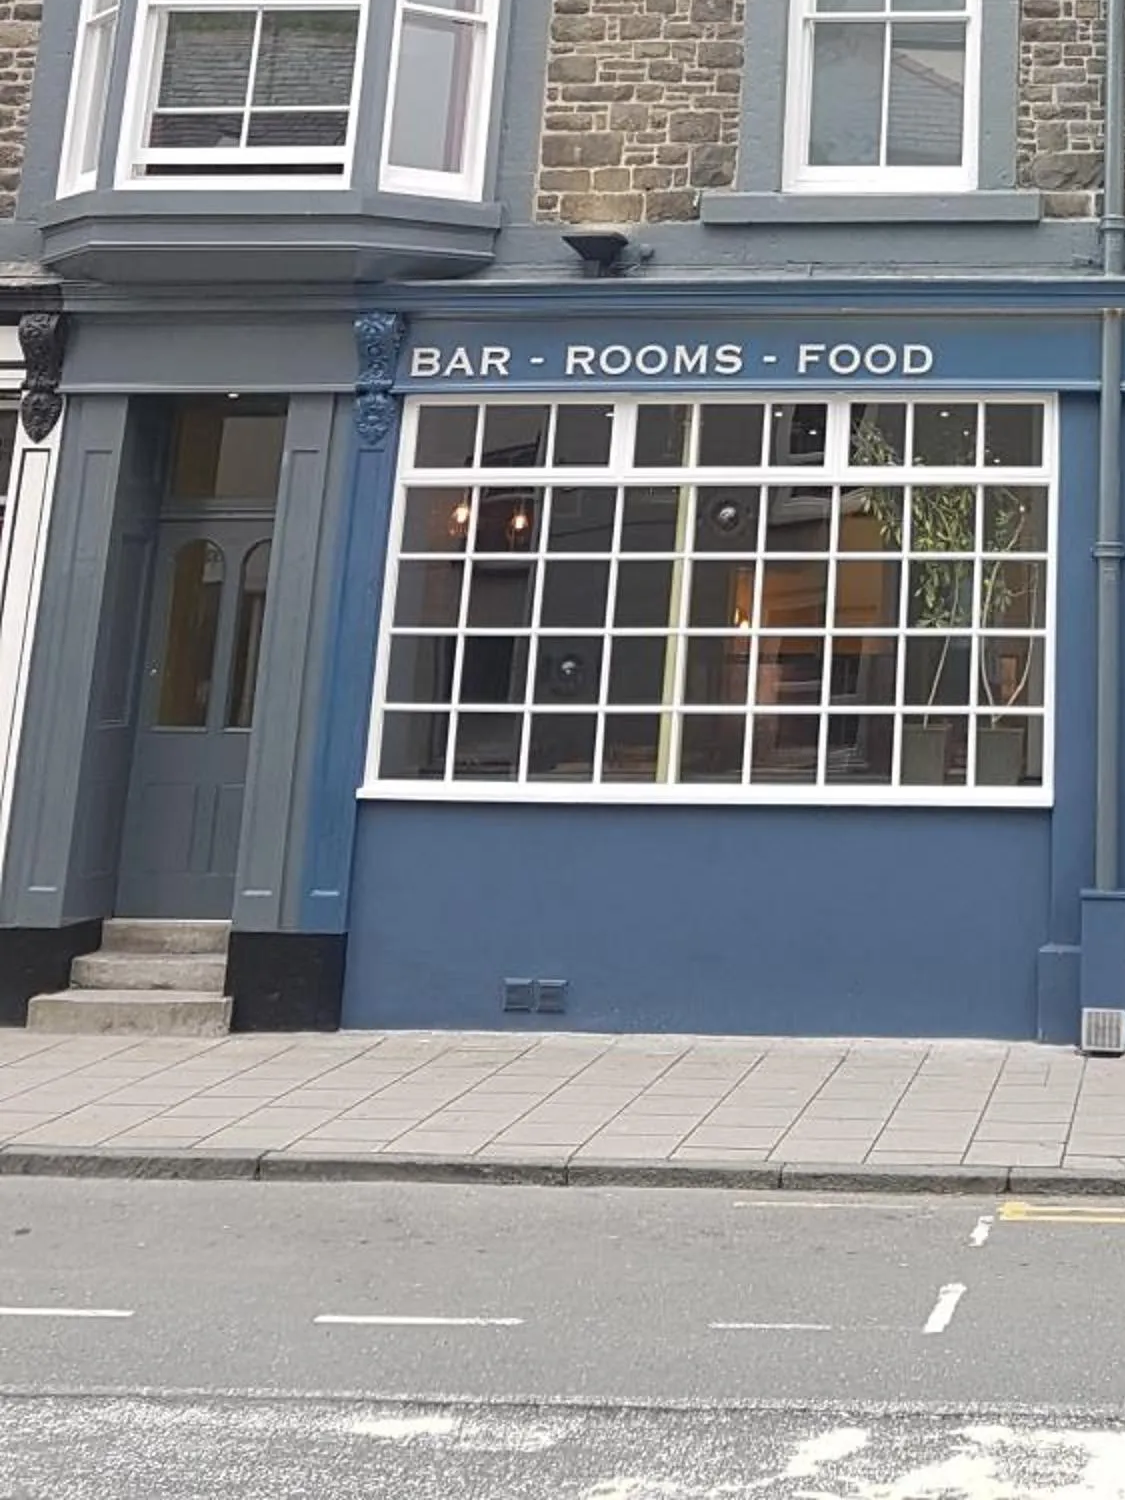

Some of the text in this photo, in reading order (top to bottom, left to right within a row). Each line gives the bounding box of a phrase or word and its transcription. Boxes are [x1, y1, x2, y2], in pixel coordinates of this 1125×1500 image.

[409, 346, 511, 377] BAR
[565, 344, 743, 375] ROOMS
[797, 343, 933, 375] FOOD
